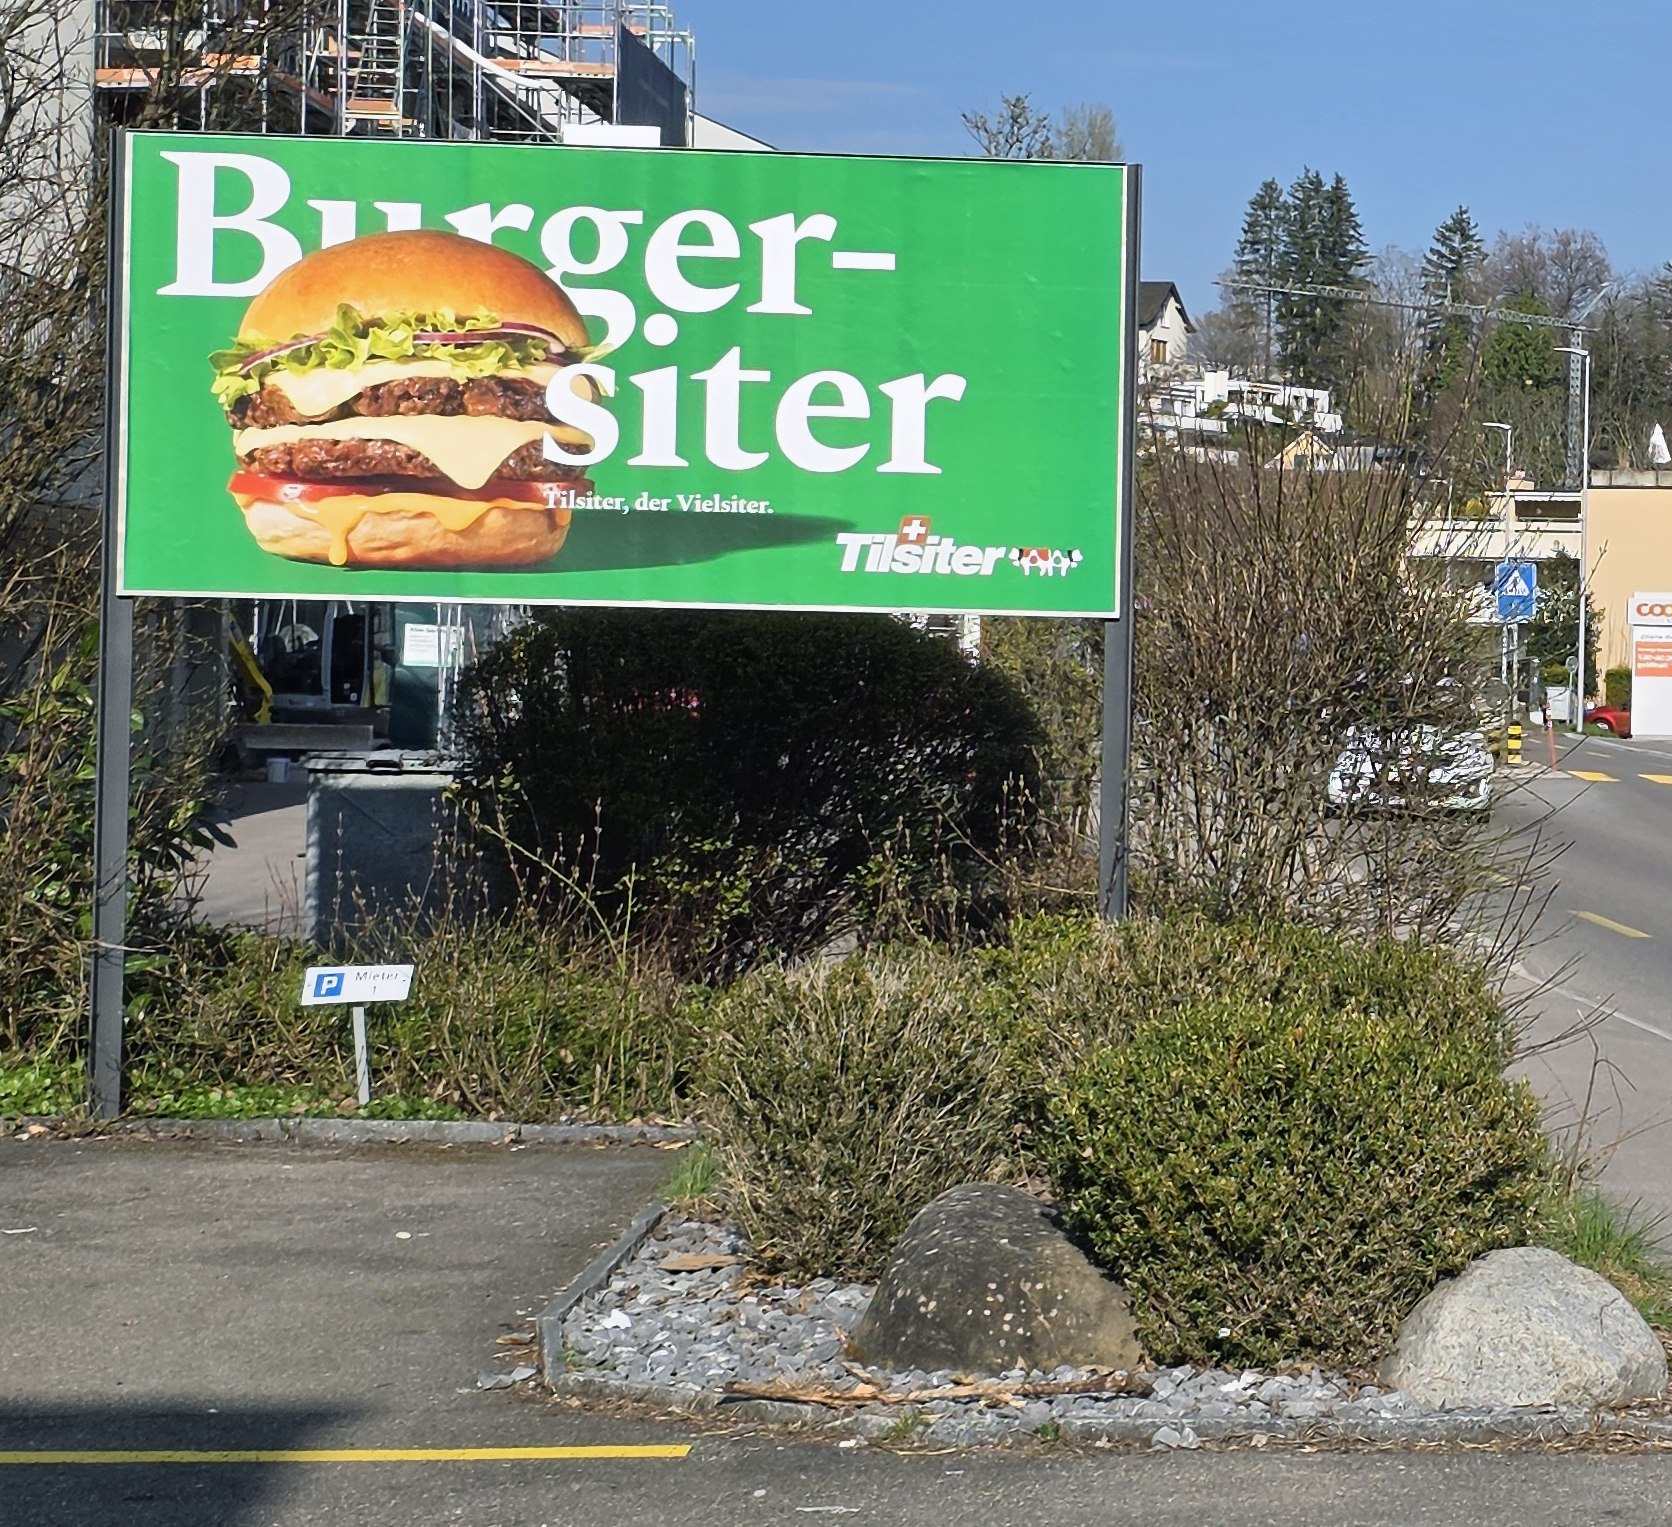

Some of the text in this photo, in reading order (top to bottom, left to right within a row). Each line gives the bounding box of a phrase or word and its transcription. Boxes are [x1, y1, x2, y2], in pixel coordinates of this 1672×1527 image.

[542, 312, 968, 475] siter
[543, 490, 774, 515] Tilsiter, der Vielsiter.
[836, 532, 1007, 576] Tilsiter
[320, 976, 339, 995] P
